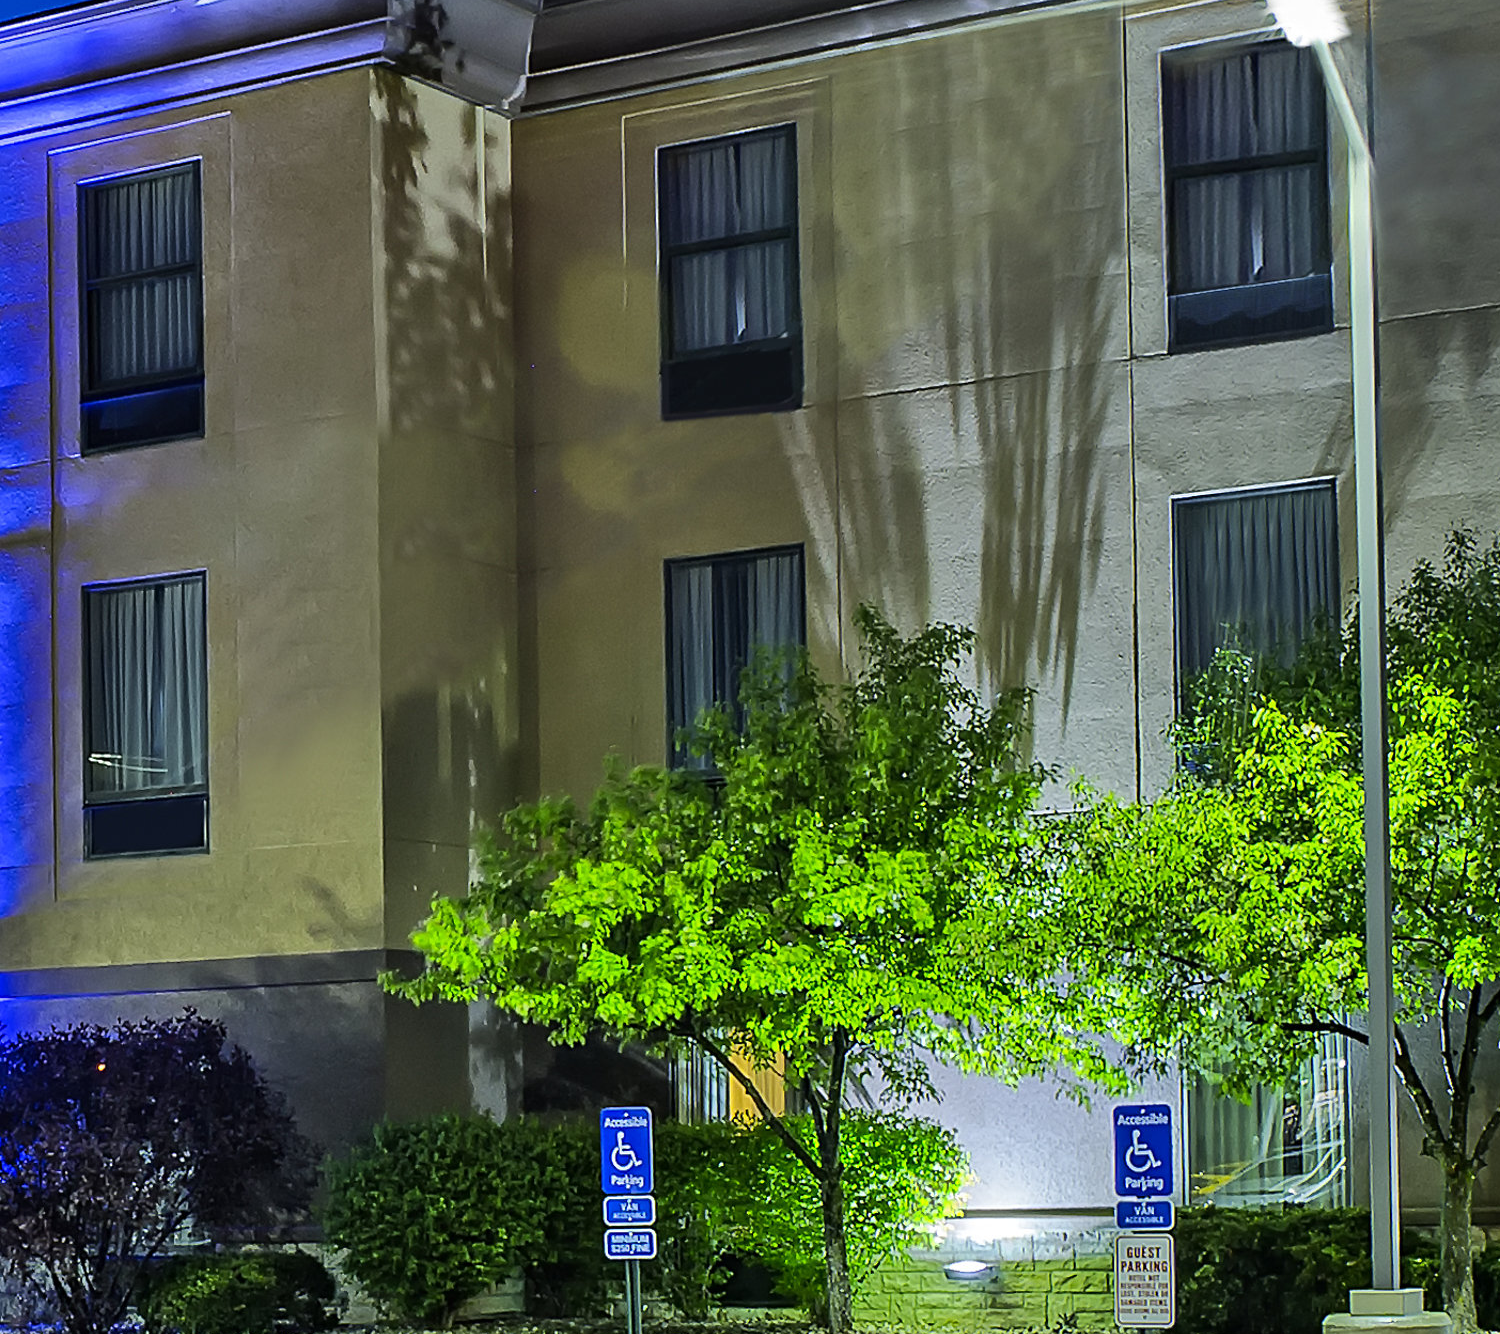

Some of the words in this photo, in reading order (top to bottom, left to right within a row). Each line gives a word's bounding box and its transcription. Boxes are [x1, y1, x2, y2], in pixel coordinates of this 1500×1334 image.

[604, 1116, 648, 1128] Accessible
[1117, 1114, 1169, 1126] Accessible
[611, 1174, 644, 1188] Parking
[1125, 1176, 1164, 1191] Parking
[620, 1202, 639, 1211] VAN
[1133, 1205, 1155, 1215] VAN
[1126, 1246, 1161, 1258] GUEST
[1120, 1260, 1168, 1272] PARKING
